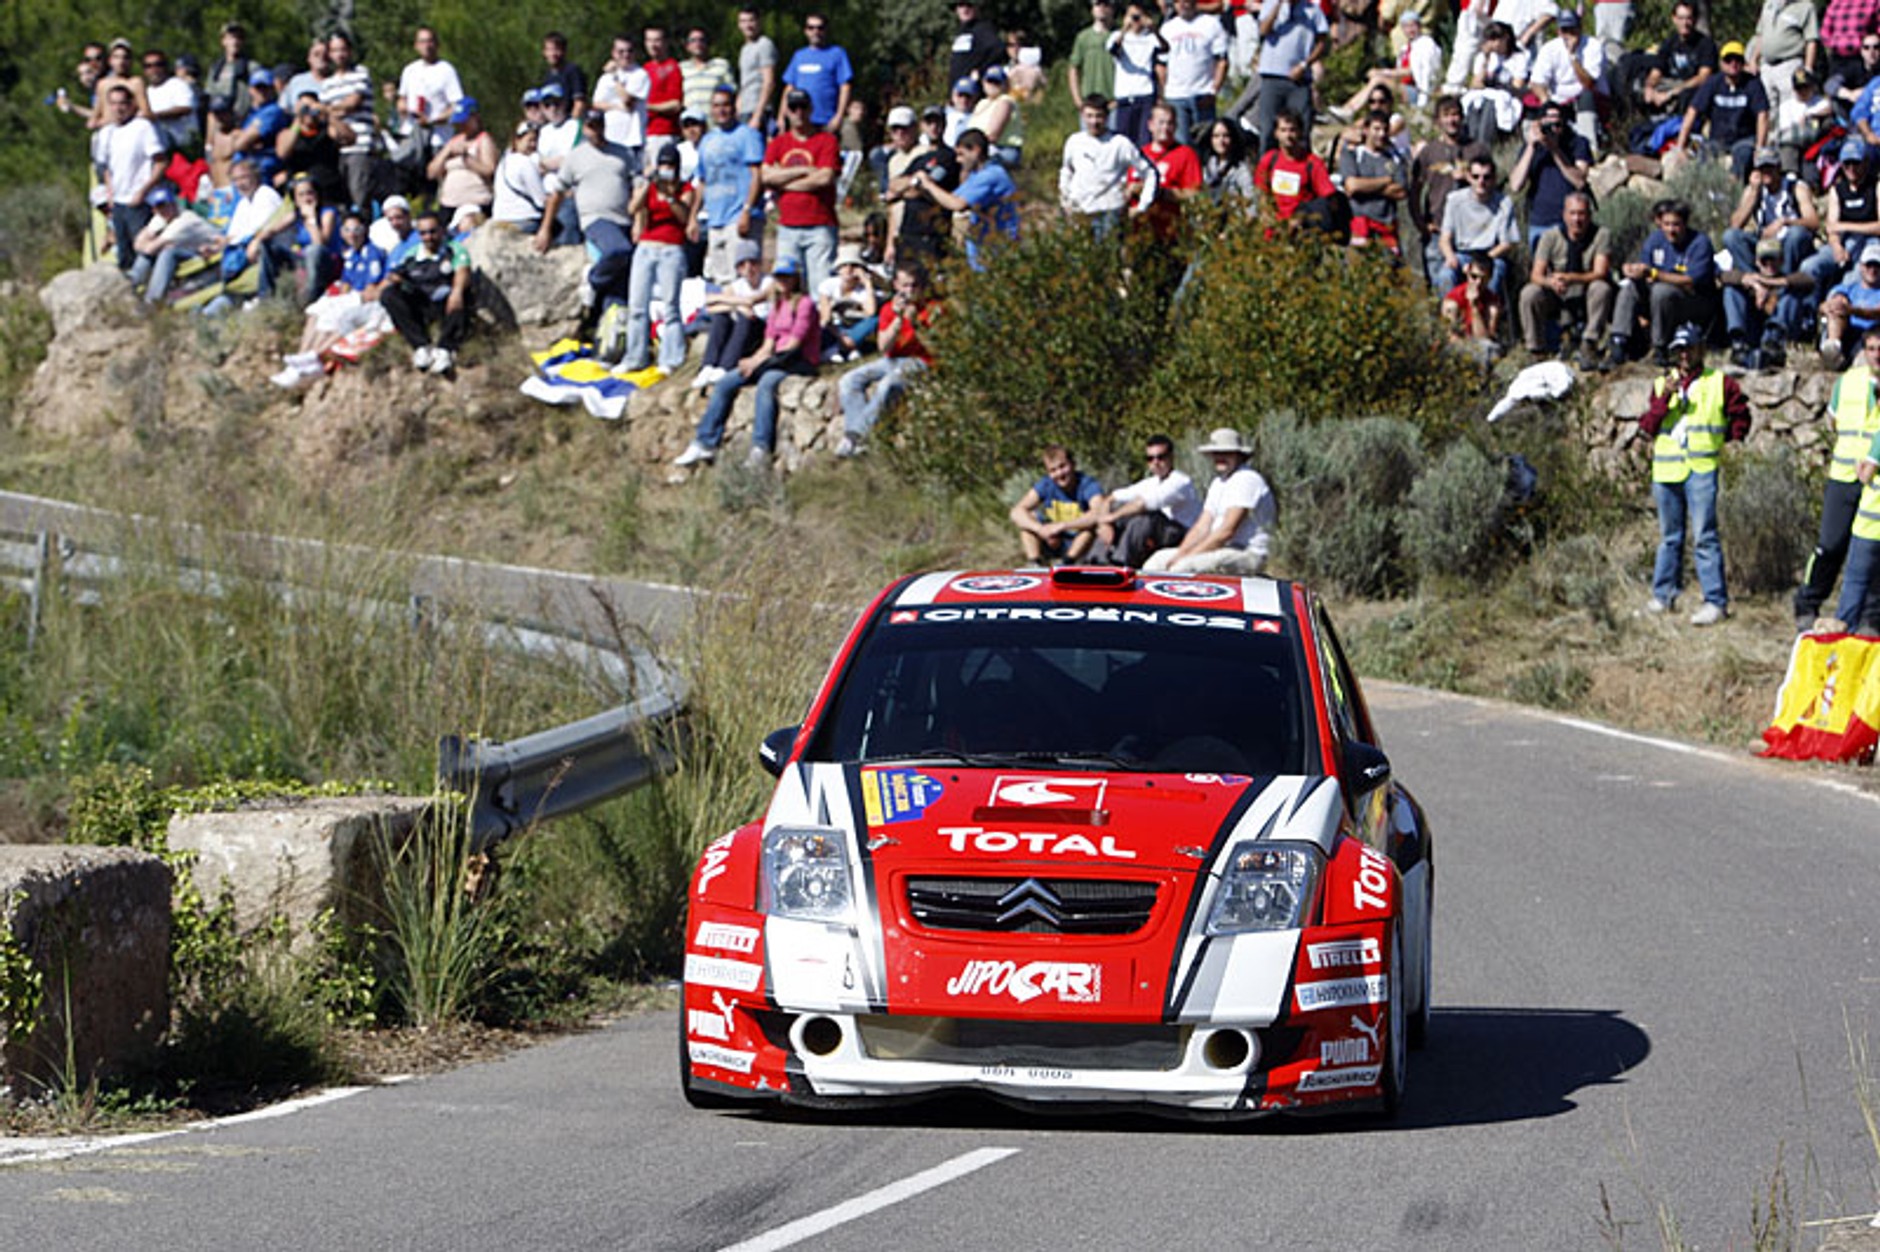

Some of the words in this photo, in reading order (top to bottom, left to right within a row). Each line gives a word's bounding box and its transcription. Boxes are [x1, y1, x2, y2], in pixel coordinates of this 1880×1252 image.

[1167, 614, 1246, 630] C2
[937, 827, 1136, 858] TOTAL
[947, 961, 1092, 1003] JIPOCAR
[1321, 1037, 1369, 1066] PUMA
